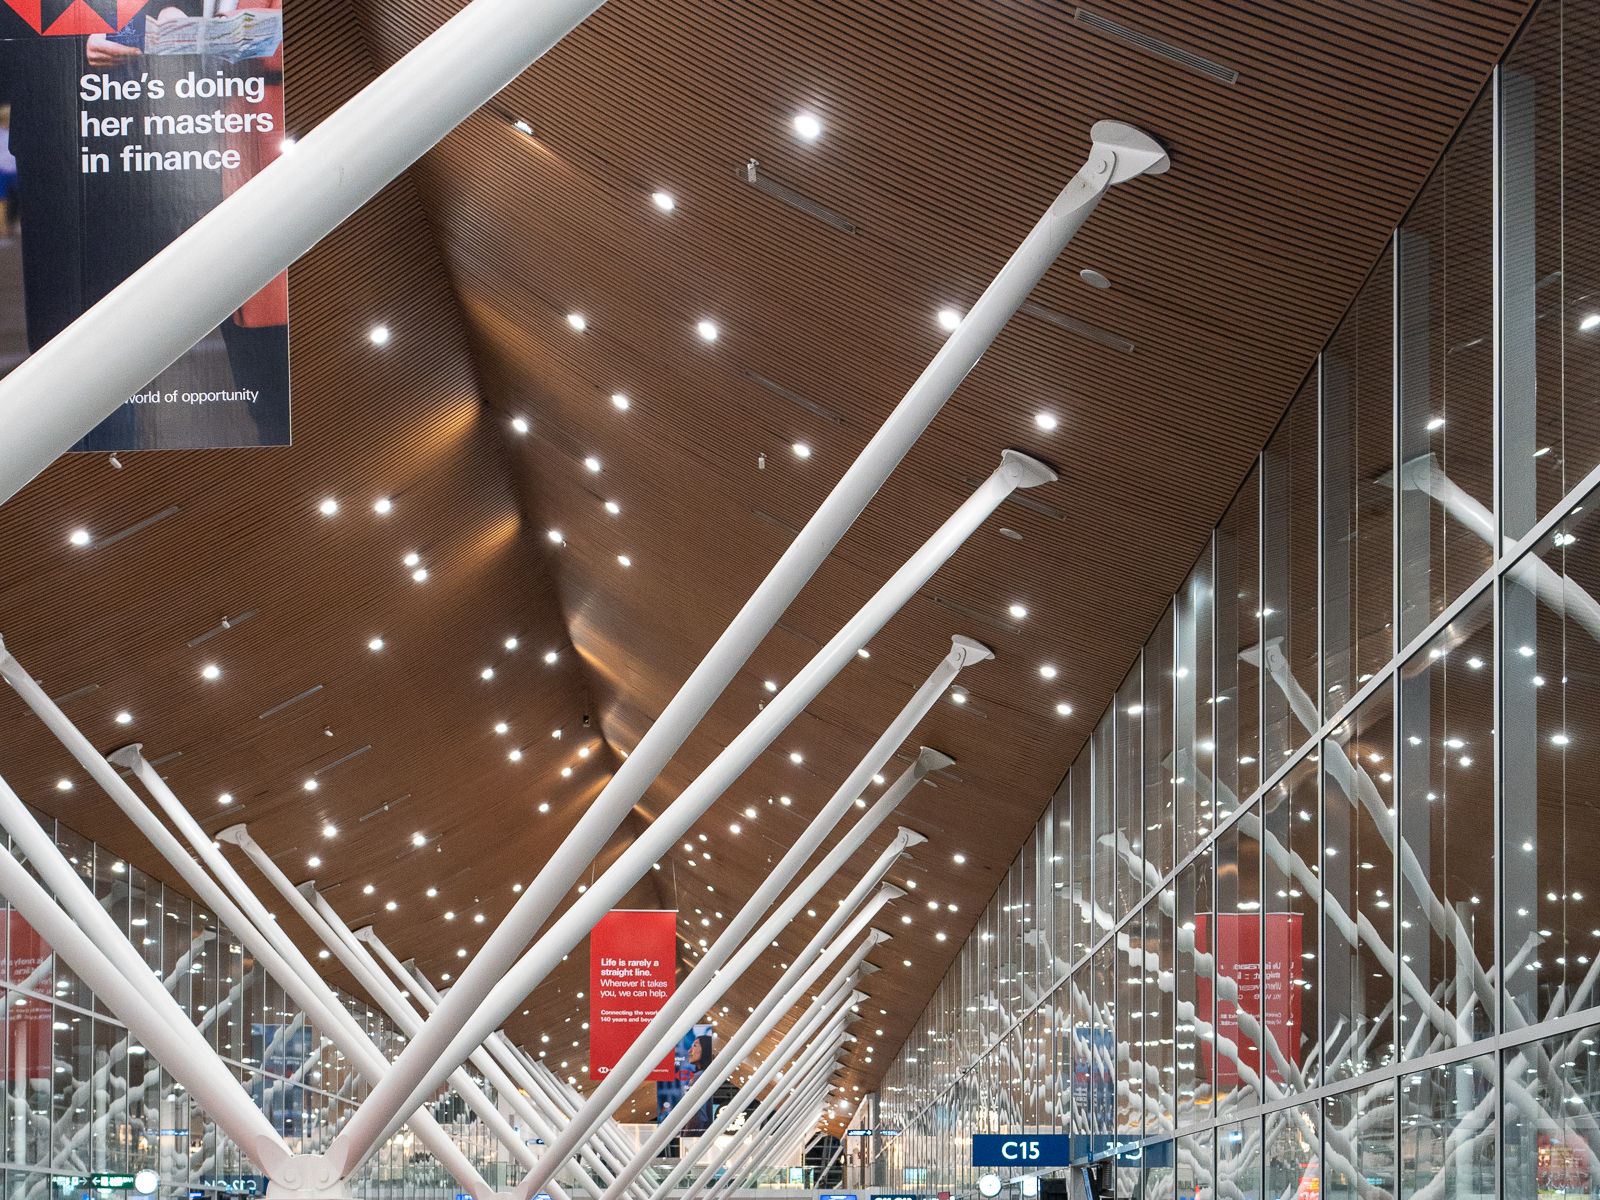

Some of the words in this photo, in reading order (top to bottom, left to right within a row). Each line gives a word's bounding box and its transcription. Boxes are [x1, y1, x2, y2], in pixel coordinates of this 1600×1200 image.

[80, 73, 165, 101] She's
[175, 71, 265, 104] doing
[81, 110, 133, 137] her
[144, 109, 274, 136] masters
[81, 146, 110, 173] in
[120, 145, 241, 173] finance
[164, 389, 178, 403] of
[181, 388, 260, 405] opportunity
[601, 958, 617, 967] Life
[618, 958, 626, 967] is
[628, 958, 652, 968] rarely
[601, 968, 633, 977] straight
[635, 968, 652, 976] line.
[601, 979, 639, 987] Wherever
[640, 979, 645, 987] it
[647, 979, 668, 987] takes
[601, 990, 617, 998] you,
[649, 989, 668, 998] help.
[1001, 1141, 1040, 1160] C15
